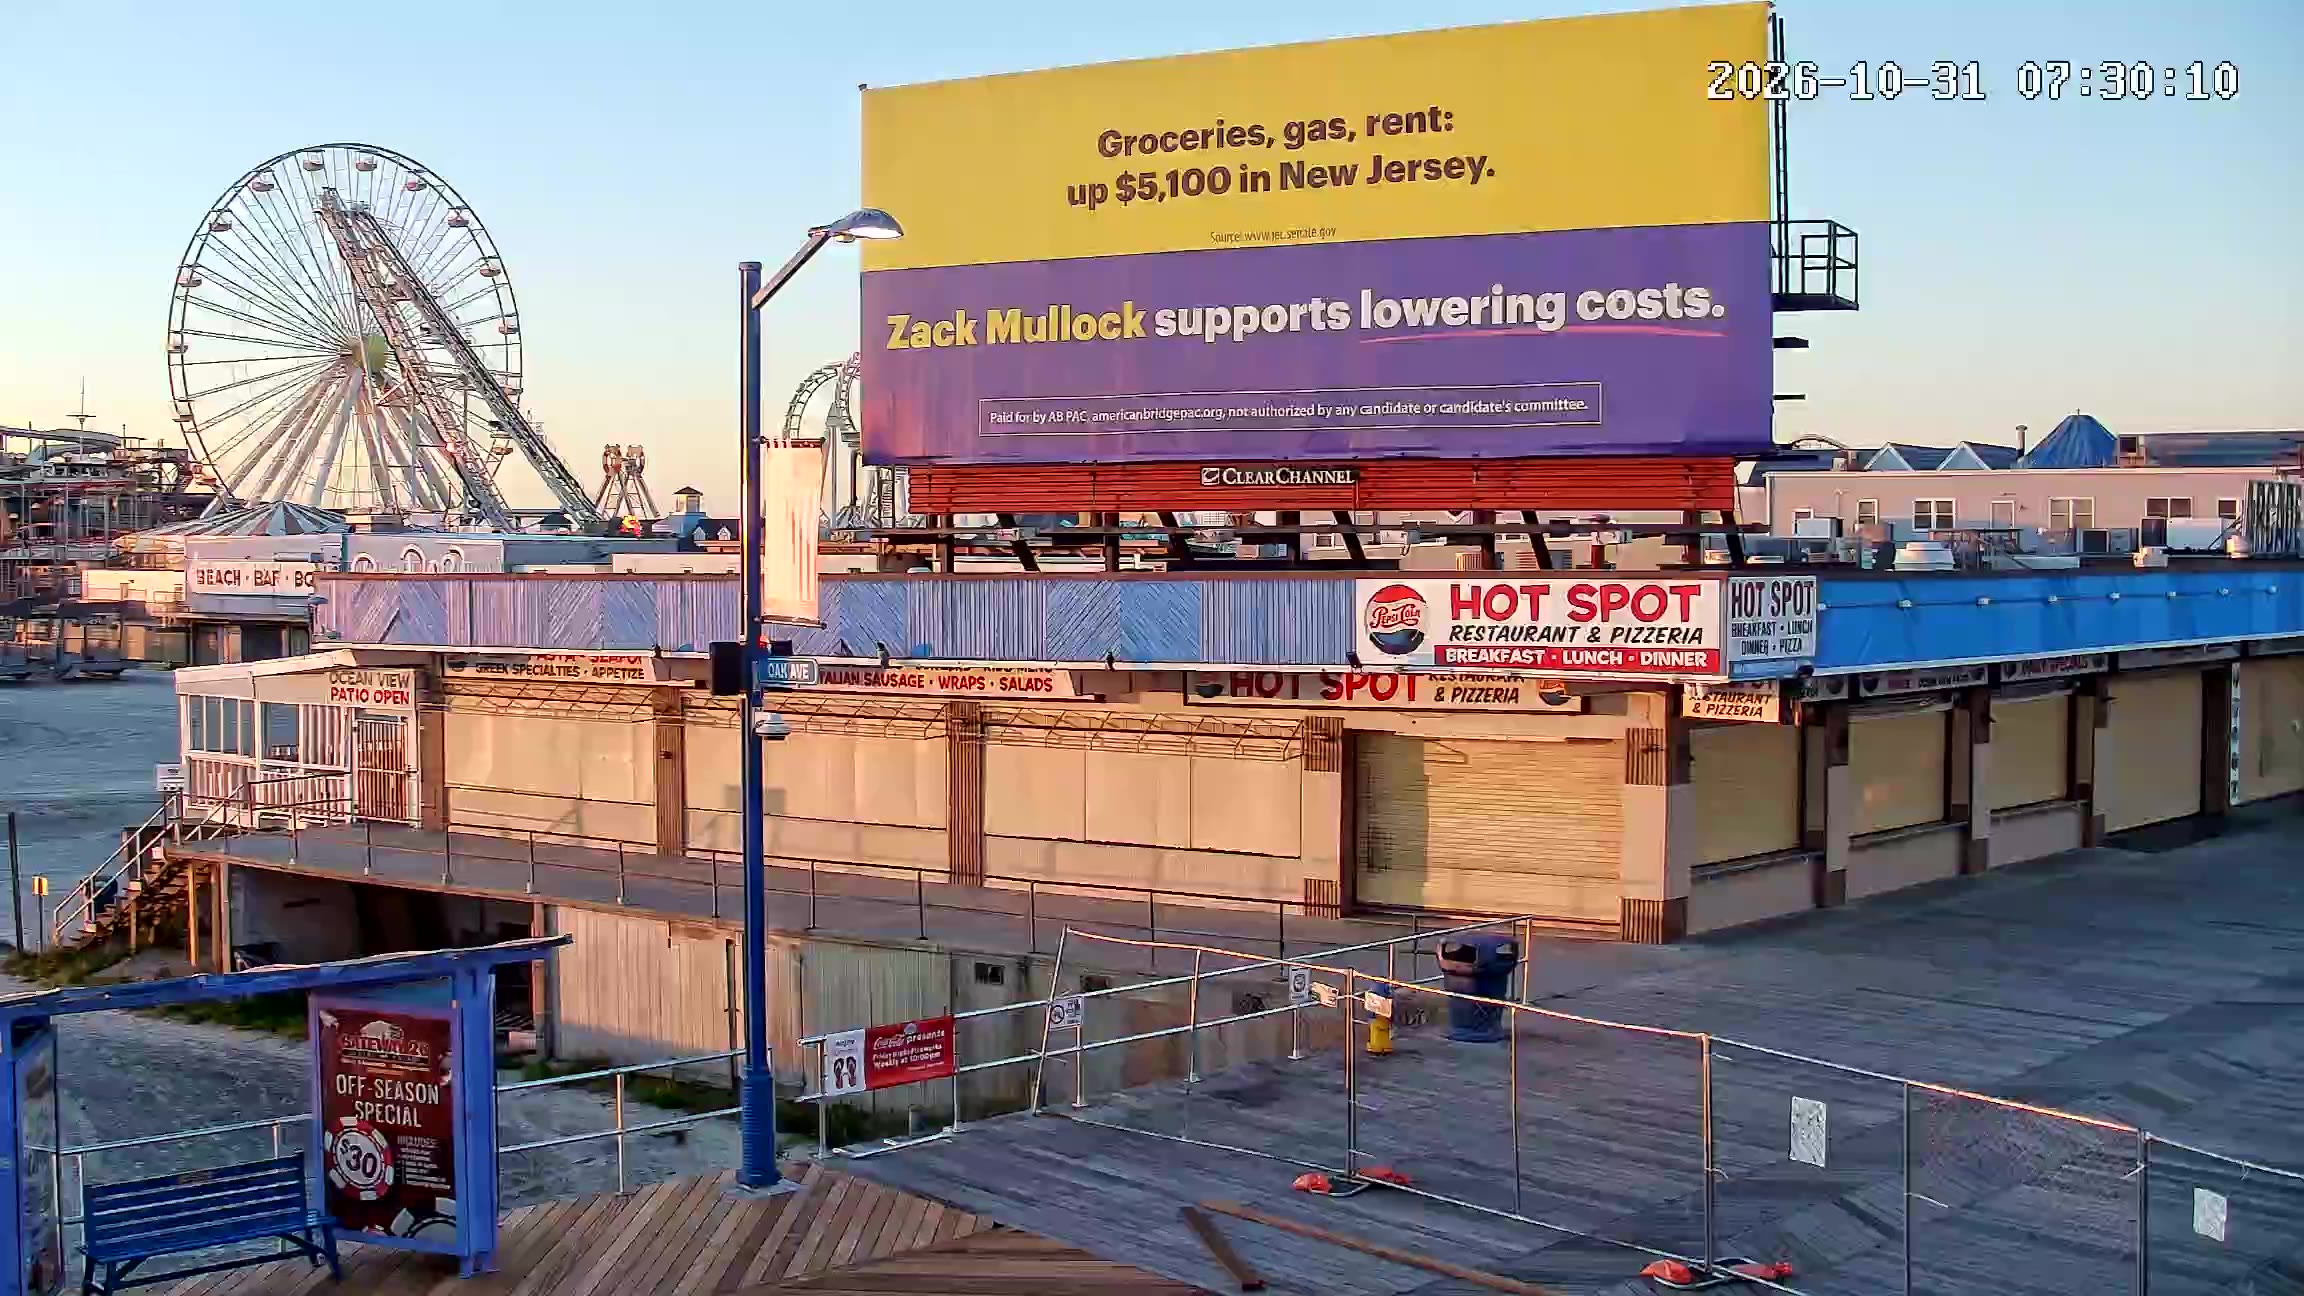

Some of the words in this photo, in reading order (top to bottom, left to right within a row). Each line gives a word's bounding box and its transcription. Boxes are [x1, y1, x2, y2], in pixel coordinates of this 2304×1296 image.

[1097, 118, 1275, 158] Groceries,
[1283, 114, 1357, 150] gas,
[1366, 105, 1455, 137] rent:
[1067, 181, 1109, 211] up
[1115, 169, 1232, 206] $5,100
[1239, 163, 1271, 193] in
[1279, 160, 1358, 191] New
[1366, 154, 1496, 186] Jersey.
[886, 310, 978, 350] Zack
[986, 301, 1149, 344] Mullock
[1154, 298, 1352, 343] supports
[1360, 283, 1566, 331] lowering
[1576, 282, 1726, 320] costs.
[990, 411, 1013, 423] Paid
[1015, 411, 1031, 423] for
[1033, 409, 1046, 425] by
[1048, 411, 1064, 423] AB
[1229, 406, 1250, 417] not
[1251, 402, 1315, 417] authorized
[1317, 402, 1332, 418] by
[1335, 405, 1358, 418] any
[1360, 401, 1421, 415] candidate
[1423, 403, 1437, 414] or
[1440, 399, 1511, 413] candidate's
[1514, 397, 1589, 412] committee.
[196, 568, 241, 586] BEACH
[1450, 583, 1551, 622] HOT
[1567, 583, 1702, 623] SPOT
[1731, 581, 1765, 618] HOT
[1770, 580, 1814, 617] SPOT
[1448, 625, 1579, 644] RESTAURANT
[1586, 625, 1602, 643] &
[1609, 627, 1704, 645] PIZZERIA
[1731, 621, 1777, 637] BREAKFAST
[1787, 619, 1813, 635] LUNCH
[1741, 639, 1768, 656] DINNER
[1779, 637, 1803, 654] PIZZA
[1446, 648, 1546, 665] BREAKFAST
[1562, 650, 1623, 666] LUNCH
[1640, 651, 1708, 668] DINNER
[329, 671, 373, 686] OCEAN
[375, 671, 410, 688] VIEW
[511, 663, 581, 678] SPECIALTIES
[767, 662, 788, 679] OAK
[789, 663, 809, 680] AVE
[819, 670, 861, 686] TALIAN
[863, 671, 926, 689] SAUSAGE
[938, 675, 986, 691] WRAPS
[999, 676, 1054, 693] SALADS
[330, 686, 369, 703] PATIO
[373, 689, 410, 705] OPEN
[1433, 686, 1445, 702] &
[1450, 686, 1520, 704] PIZZERIA
[1692, 702, 1701, 714] &
[1705, 703, 1763, 719] PIZZERIA
[336, 1074, 439, 1104] OFF-SEASON
[354, 1100, 422, 1128] SPECIAL
